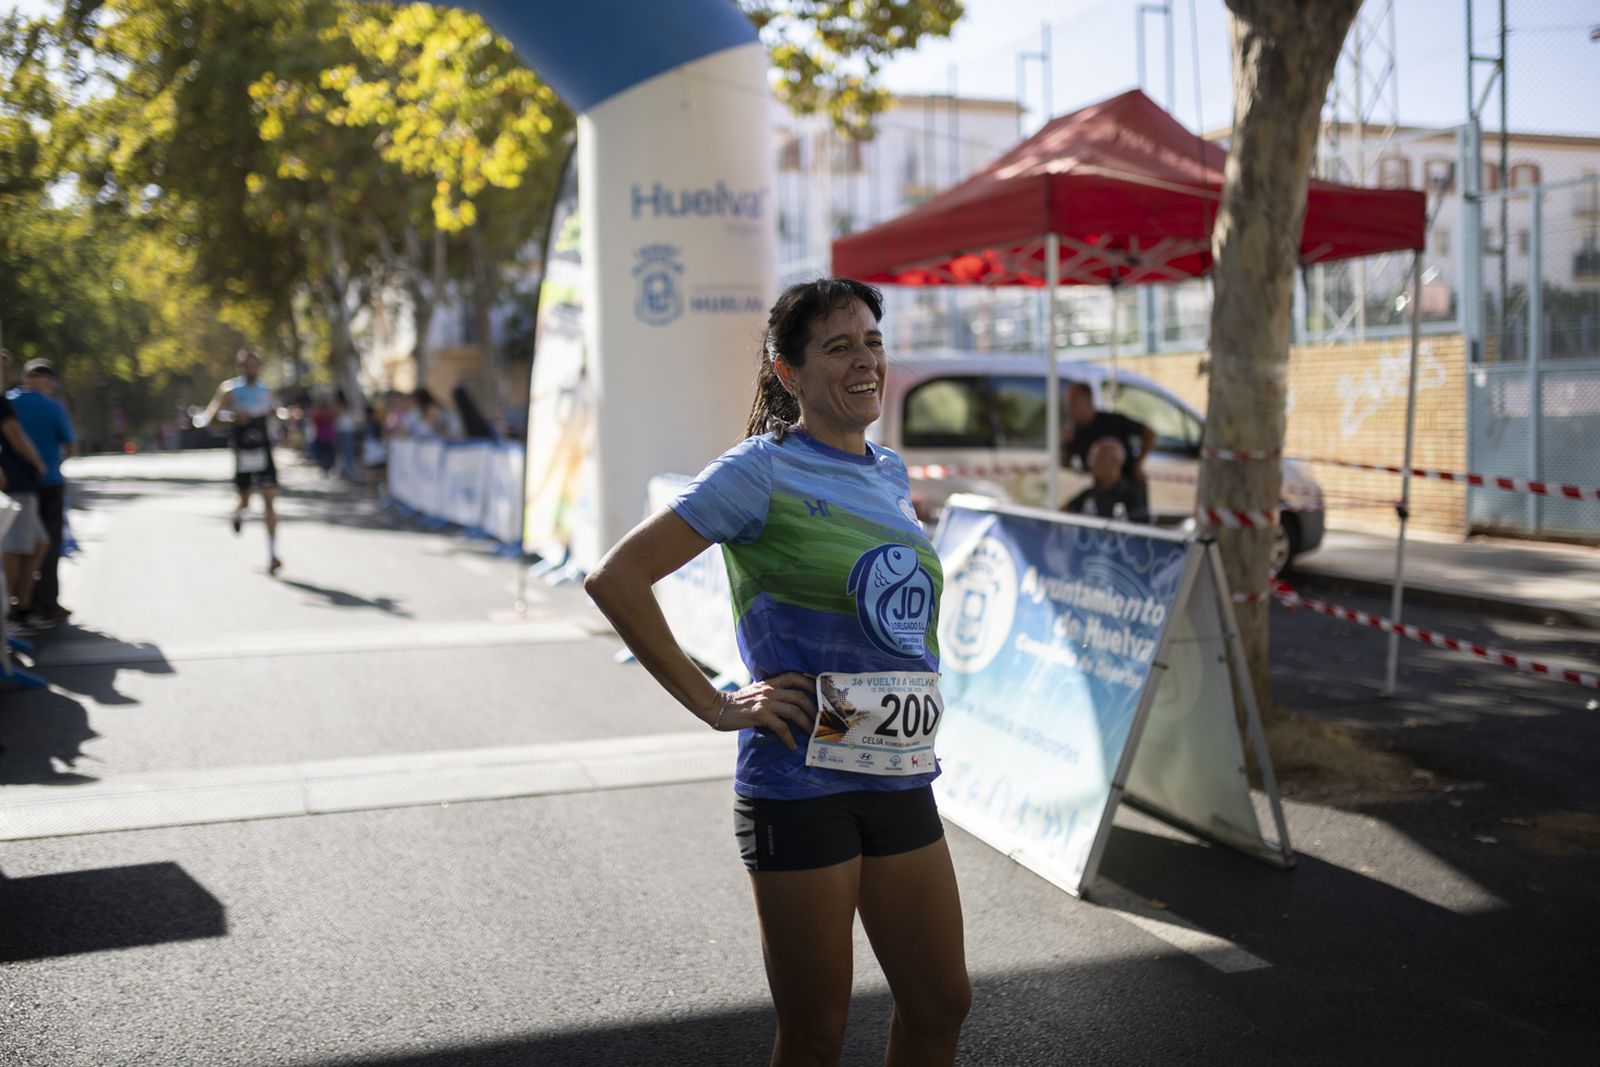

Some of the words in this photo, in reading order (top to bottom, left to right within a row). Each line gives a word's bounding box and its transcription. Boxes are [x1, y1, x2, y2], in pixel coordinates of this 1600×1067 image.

[892, 586, 926, 620] JD
[1020, 566, 1166, 627] Ayuntamiento
[1084, 616, 1156, 663] Huelva
[874, 693, 940, 738] 200
[862, 736, 884, 745] CELIA
